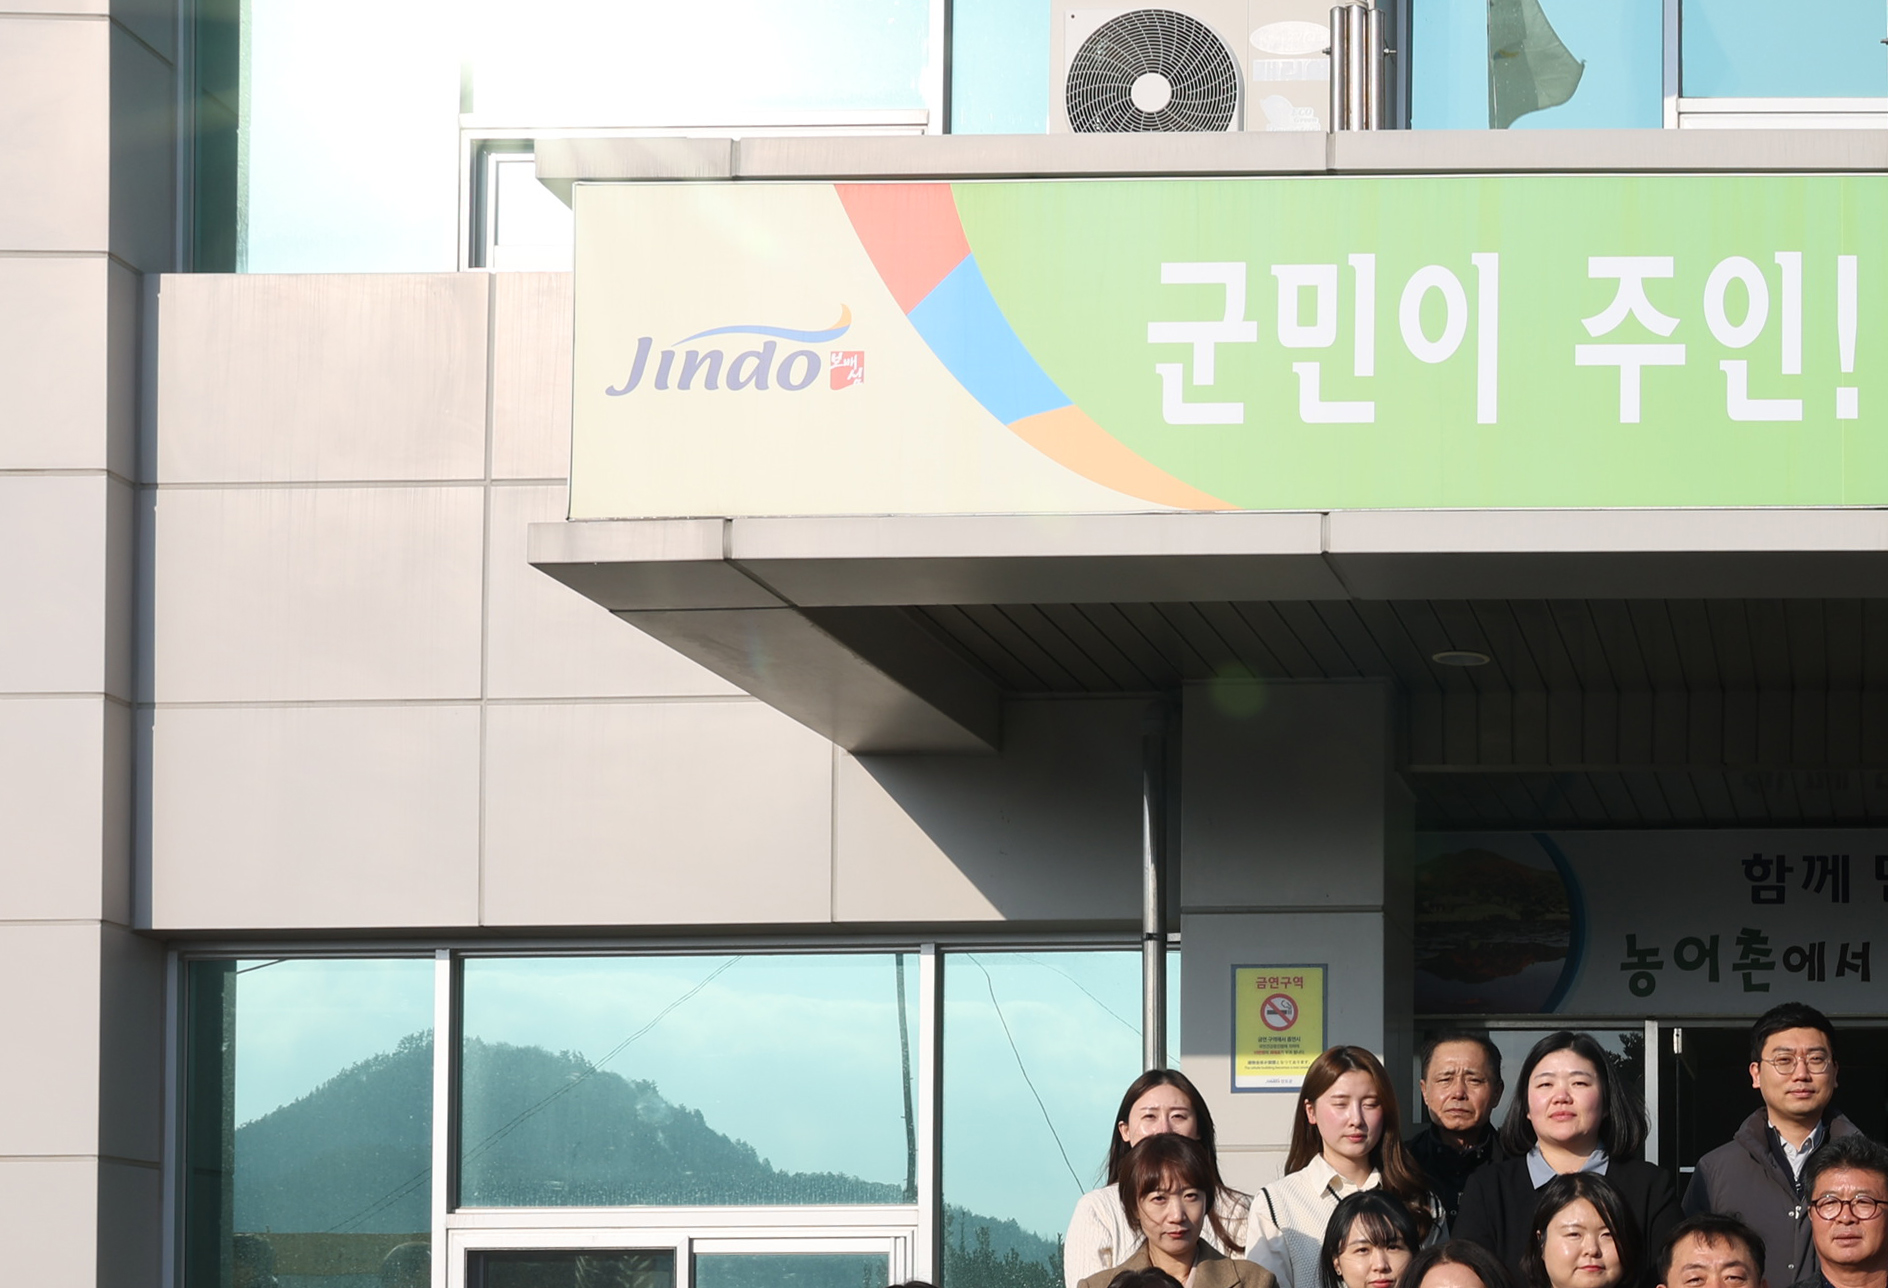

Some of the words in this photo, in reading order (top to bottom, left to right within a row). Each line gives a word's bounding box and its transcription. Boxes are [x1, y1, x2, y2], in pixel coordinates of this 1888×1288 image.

[605, 336, 822, 397] Jindo
[1147, 252, 1499, 425] 군민이
[1574, 251, 1859, 424] 주인!
[1741, 852, 1850, 905] 함께
[1256, 976, 1304, 989] 금연구역
[1619, 927, 1871, 997] 농어촌에서
